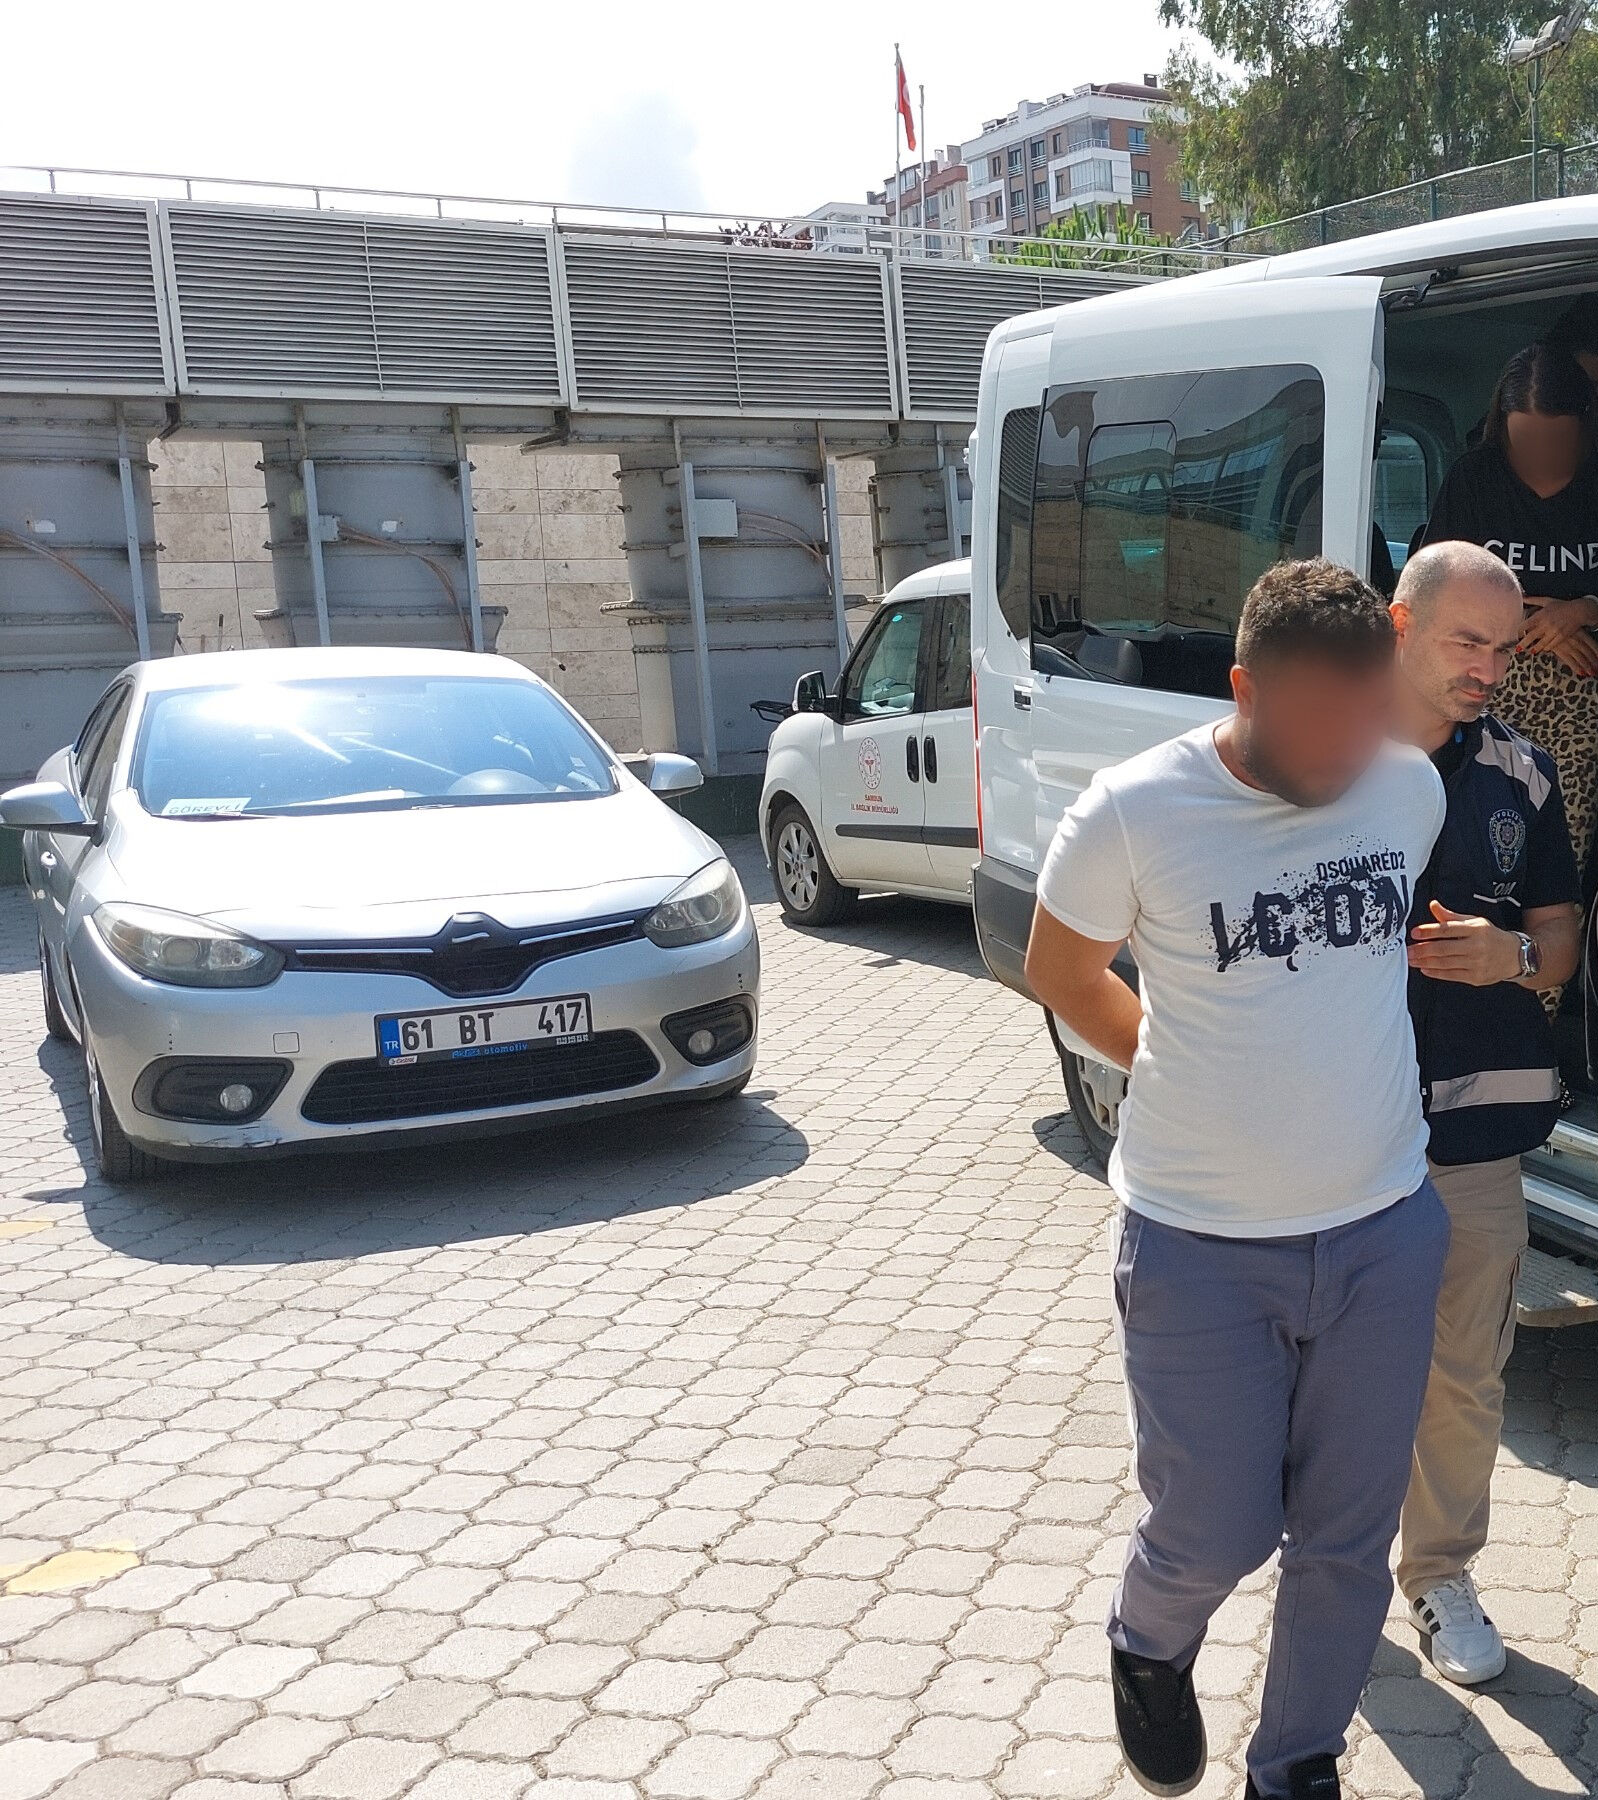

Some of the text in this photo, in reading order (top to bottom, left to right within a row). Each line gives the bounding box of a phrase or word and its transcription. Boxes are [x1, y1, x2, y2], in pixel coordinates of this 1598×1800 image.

[1316, 851, 1406, 881] DSQUARED2
[1209, 874, 1410, 973] ICON
[384, 1040, 399, 1050] TR
[401, 1002, 582, 1051] 61 BT 417
